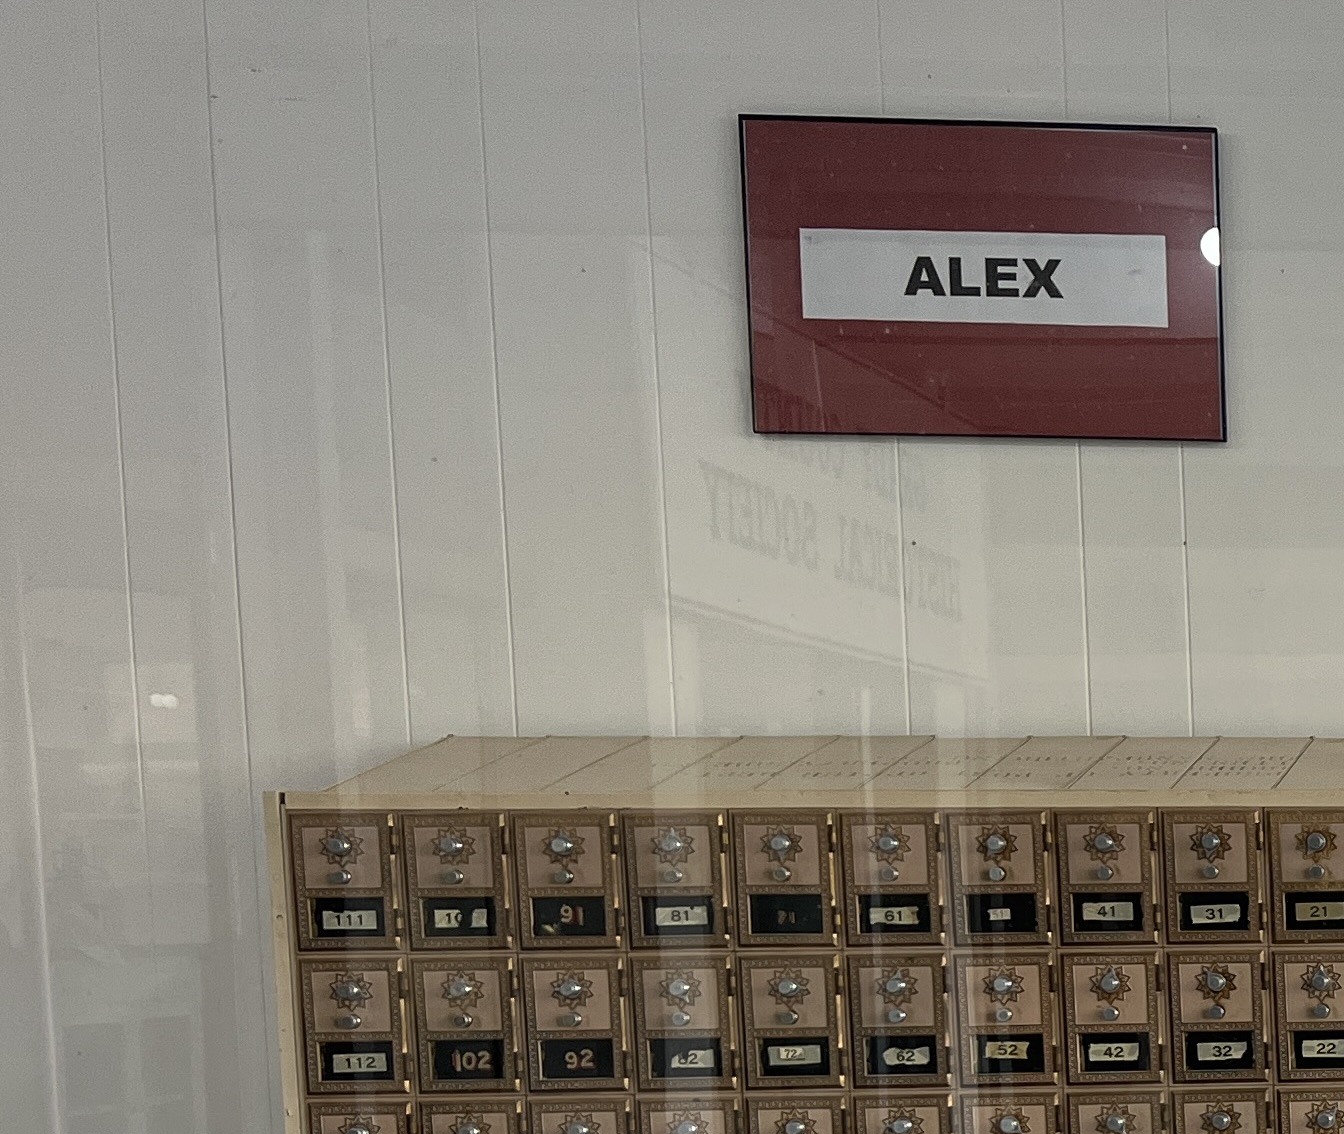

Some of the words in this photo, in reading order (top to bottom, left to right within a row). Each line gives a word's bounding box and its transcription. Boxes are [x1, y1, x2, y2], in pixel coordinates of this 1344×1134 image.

[904, 256, 1064, 298] ALEX
[560, 904, 584, 926] 91
[671, 910, 690, 922] 81
[884, 910, 903, 922] 61
[1097, 907, 1116, 917] 41
[1205, 908, 1224, 920] 31
[1310, 906, 1328, 917] 21
[335, 914, 364, 927] 111
[783, 1049, 798, 1058] 72
[997, 1044, 1019, 1056] 52
[1103, 1047, 1125, 1058] 42
[1212, 1046, 1233, 1058] 32
[1316, 1043, 1337, 1055] 22
[452, 1049, 492, 1072] 102
[564, 1048, 596, 1070] 92
[896, 1050, 916, 1063] 62
[345, 1057, 377, 1069] 112
